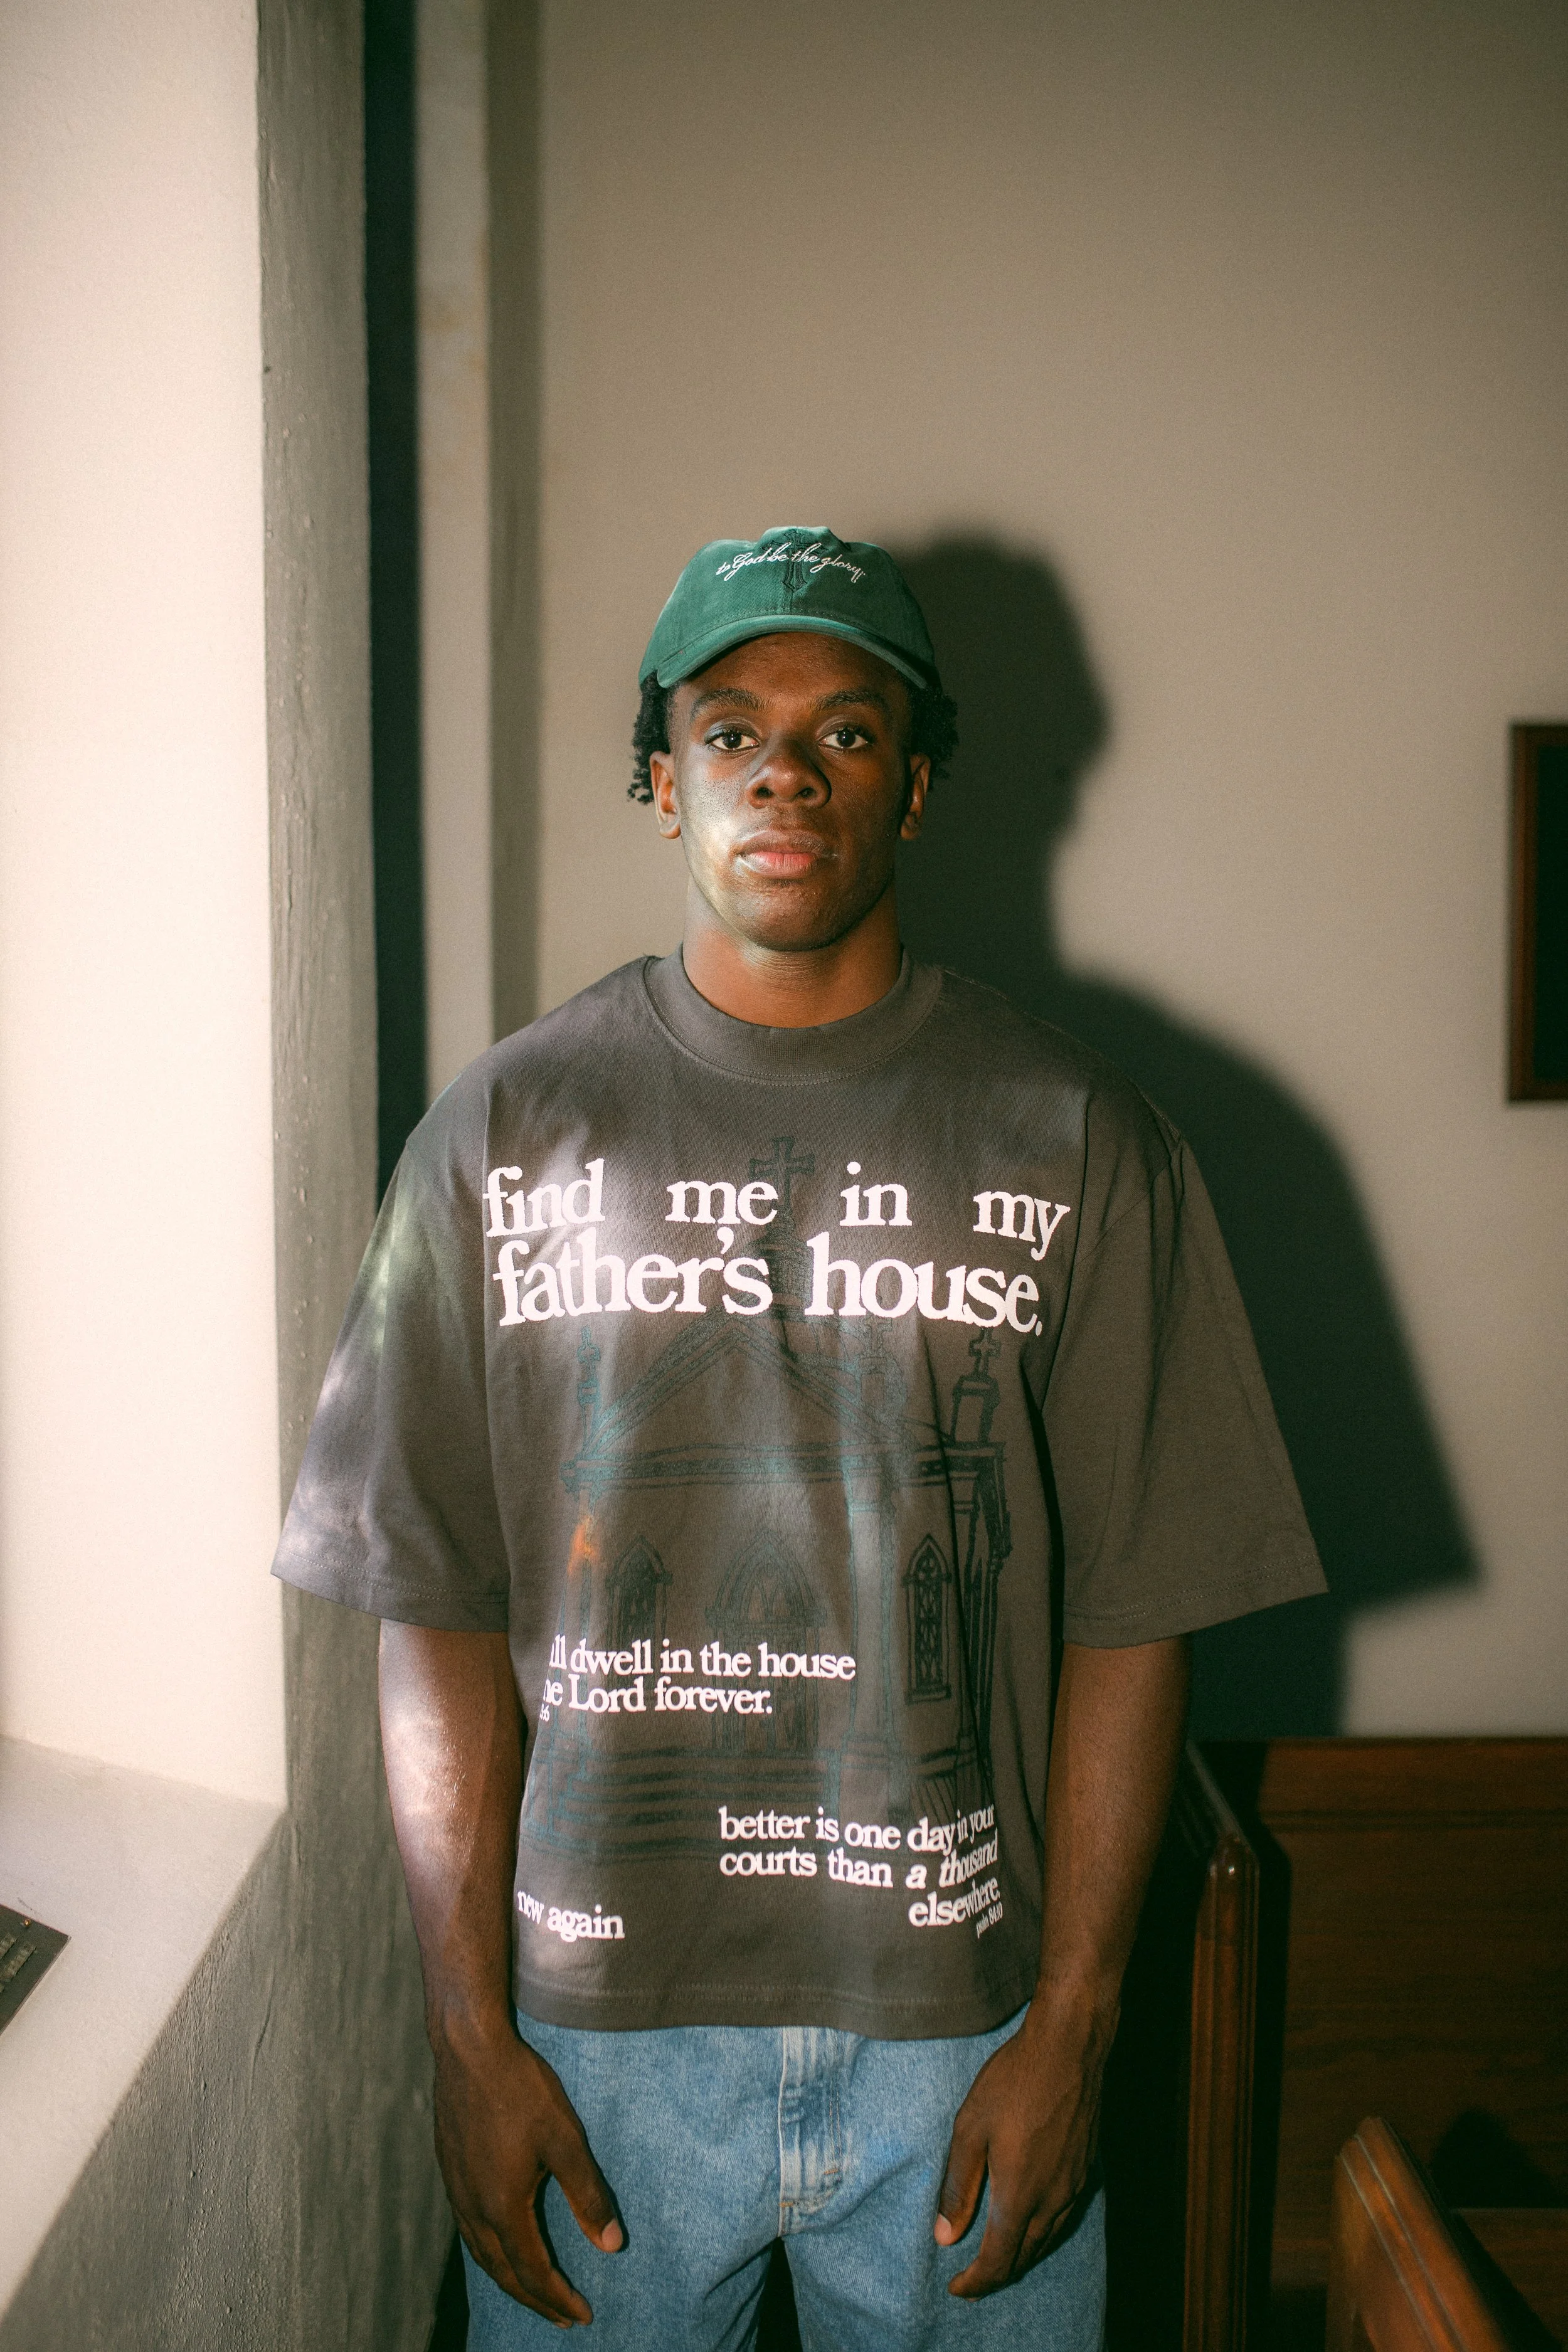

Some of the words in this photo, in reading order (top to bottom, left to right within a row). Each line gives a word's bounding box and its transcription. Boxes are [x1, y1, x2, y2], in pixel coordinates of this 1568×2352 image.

[723, 547, 771, 581] God
[767, 542, 792, 562] be
[791, 543, 821, 563] the
[483, 1158, 606, 1237] find
[665, 1180, 778, 1225] me
[839, 1161, 913, 1227] in
[973, 1190, 1071, 1261] my
[493, 1226, 773, 1327] father's
[804, 1231, 1042, 1337] house.
[570, 1638, 654, 1677] dwell
[660, 1638, 694, 1673] in
[699, 1641, 751, 1677] the
[758, 1642, 856, 1680] house
[568, 1673, 646, 1713] Lord
[654, 1675, 773, 1714] forever.
[718, 1805, 811, 1840] better
[815, 1806, 839, 1842] is
[844, 1821, 901, 1850] one
[907, 1816, 955, 1856] day
[956, 1809, 969, 1845] in
[969, 1804, 995, 1844] your
[719, 1846, 817, 1877] courts
[827, 1846, 893, 1888] than
[905, 1863, 927, 1889] a
[938, 1827, 998, 1888] thousand
[547, 1904, 625, 1942] again
[908, 1877, 1000, 1927] elsewhere.
